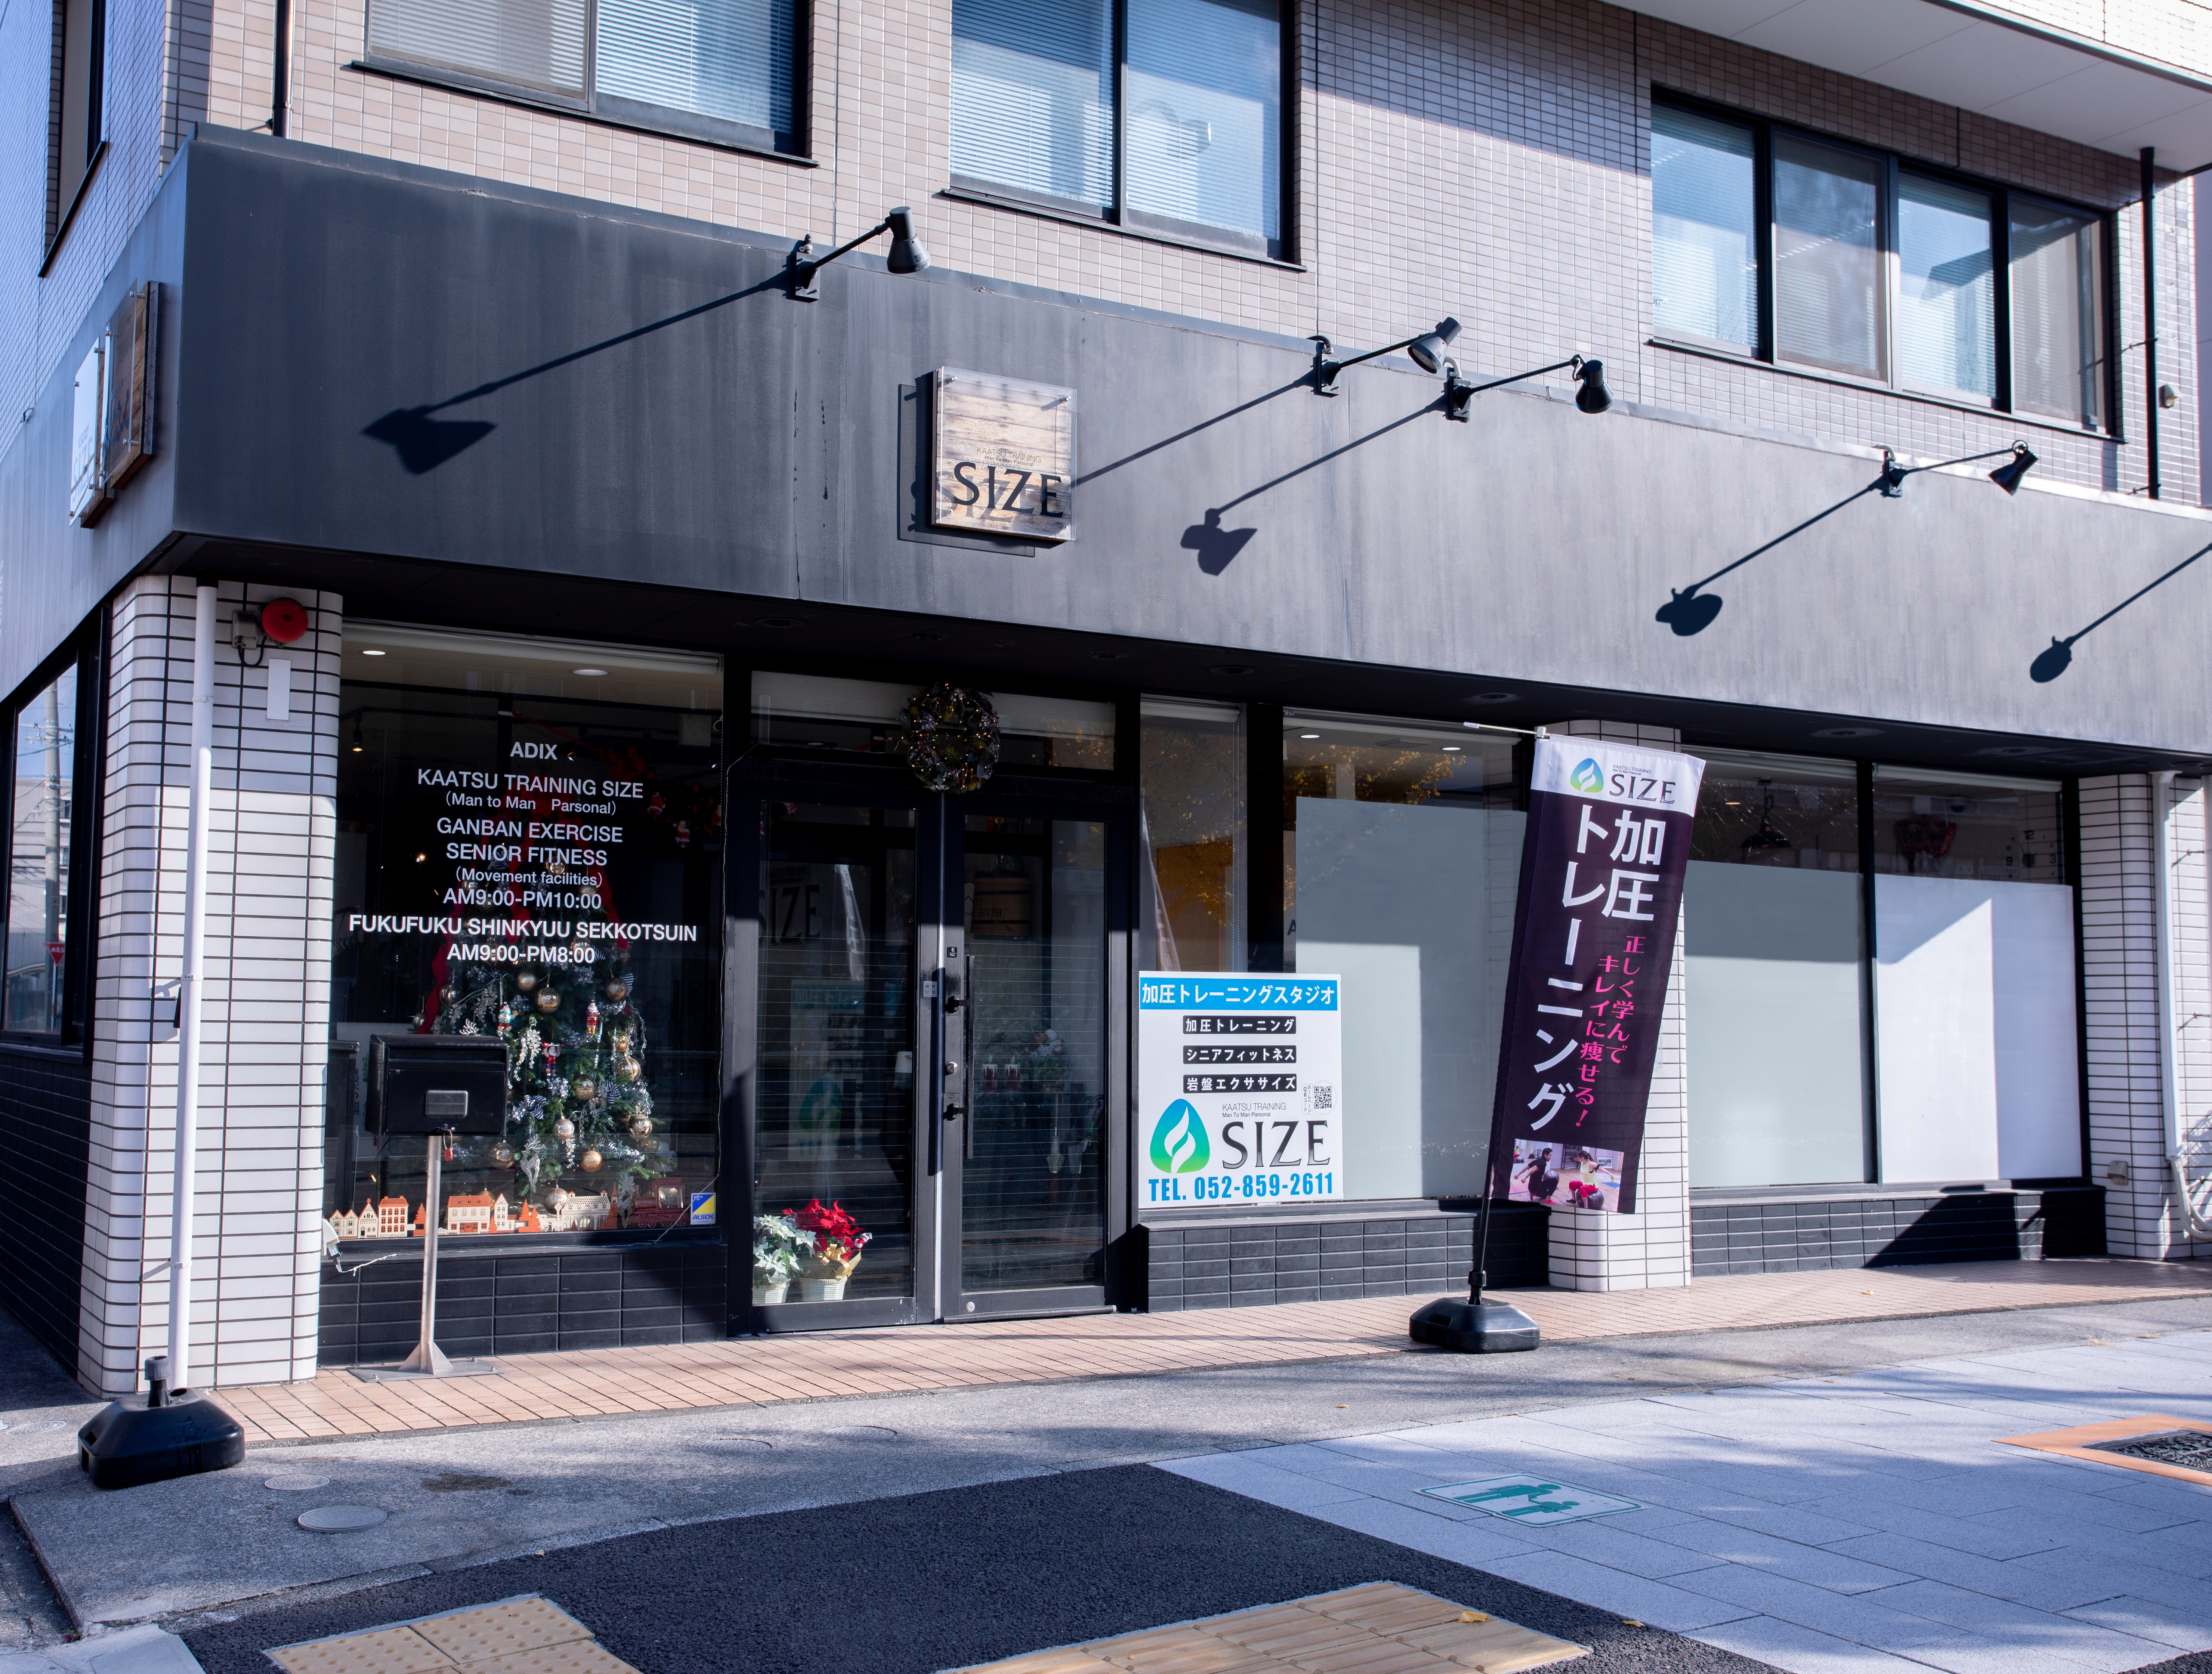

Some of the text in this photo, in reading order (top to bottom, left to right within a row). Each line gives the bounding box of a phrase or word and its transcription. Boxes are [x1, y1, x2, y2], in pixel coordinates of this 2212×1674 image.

[977, 447, 1041, 463] KAATSU TRAINING
[954, 461, 1064, 518] SIZE
[510, 742, 558, 760] ADIX
[418, 769, 644, 799] KAATSU TRAINING SIZE
[1609, 774, 1676, 804] SIZE
[446, 791, 617, 816] (Man to Man Parsonal)
[437, 818, 623, 843] GANBAN EXERCISE
[447, 843, 608, 866] SENIOR FITNESS
[1601, 810, 1666, 921] 加圧
[456, 865, 603, 887] (Movement facilities)
[443, 888, 602, 909] AM9:00-PM10:00
[349, 914, 697, 942] FUKUFUKU SHINKYUU SEKKOTSUIN
[447, 943, 595, 964] AM9:00-PM8:00
[1528, 804, 1608, 1131] トレーニング
[1142, 983, 1335, 1005] 加圧トレーニングスタジオ
[1606, 936, 1646, 1064] 正しく学んで
[1186, 1019, 1294, 1033] 加圧トレーニング
[1186, 1048, 1294, 1062] シニアフィットネス
[1187, 1075, 1296, 1092] 岩盤エクササイズ
[1223, 1102, 1286, 1111] KAATSU TRAINING
[1221, 1120, 1331, 1170] SIZE
[1149, 1172, 1332, 1201] TEL. 052-859-2611
